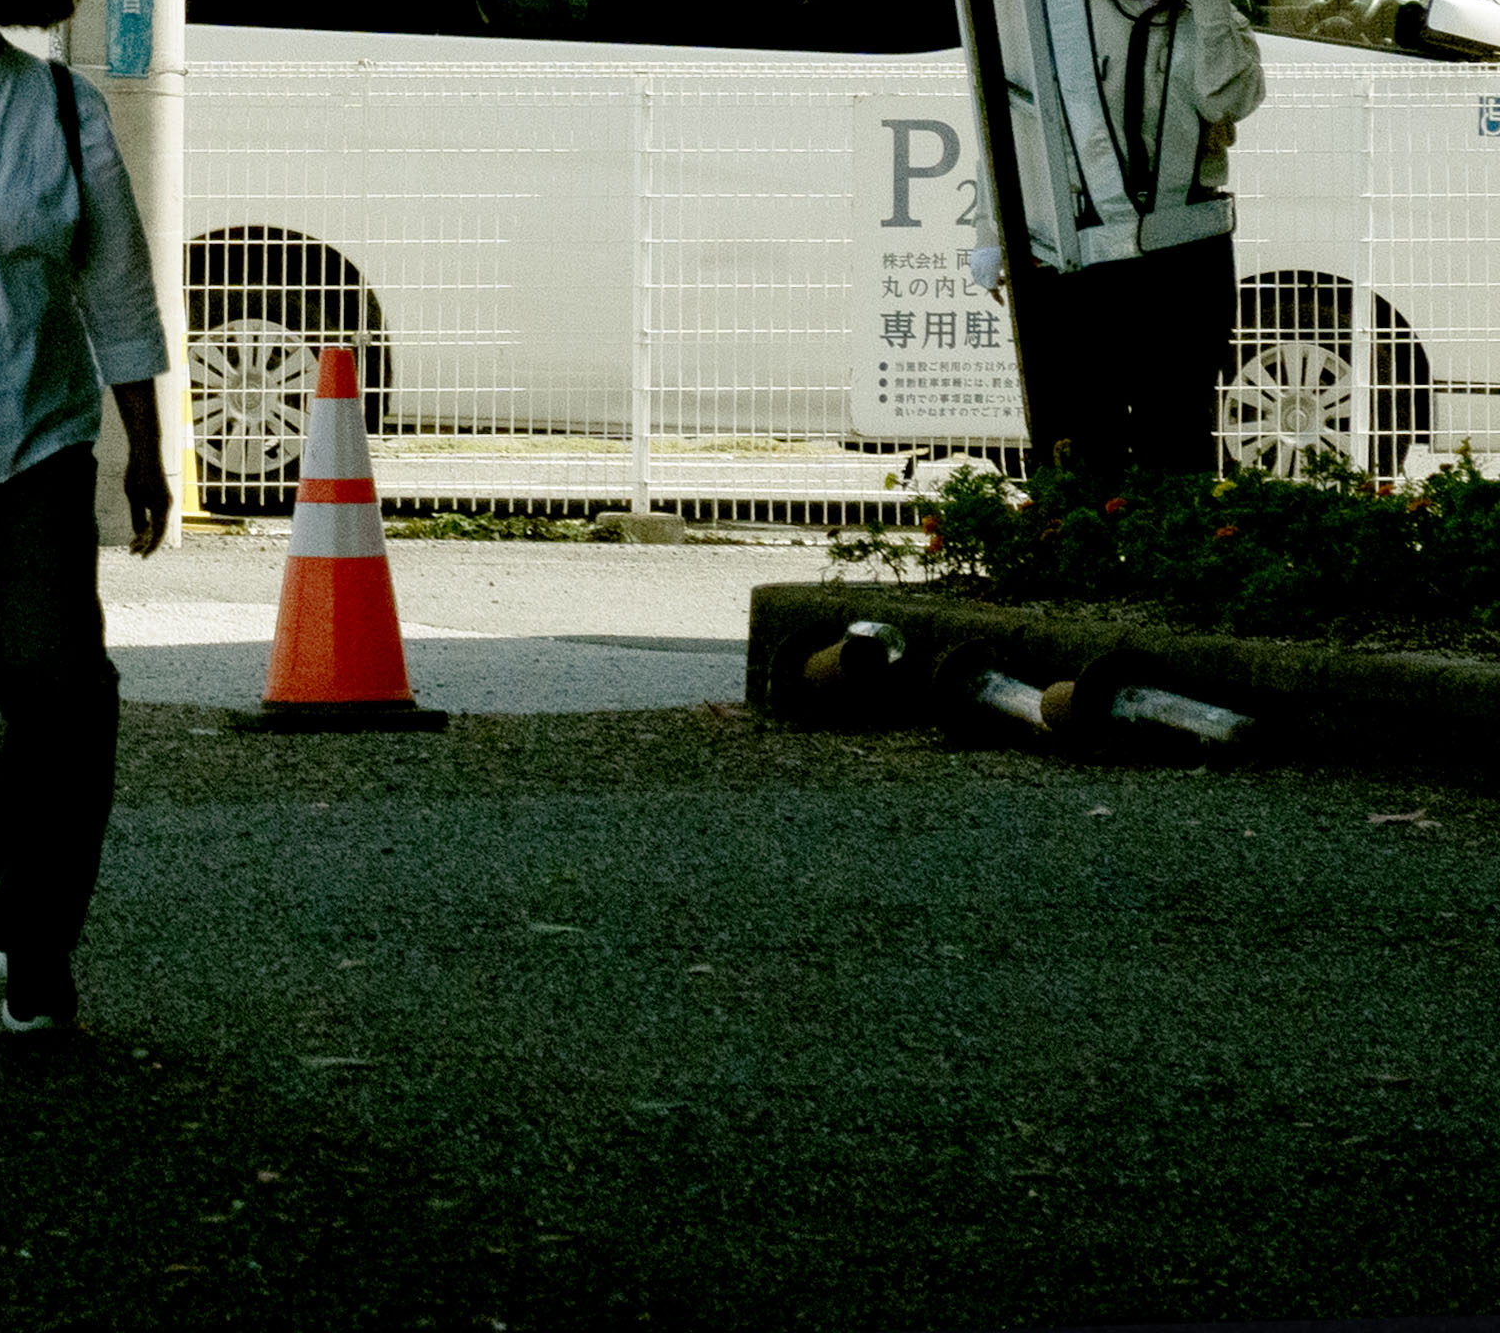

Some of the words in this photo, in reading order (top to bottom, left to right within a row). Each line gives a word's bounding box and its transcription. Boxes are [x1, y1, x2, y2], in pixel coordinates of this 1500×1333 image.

[882, 251, 948, 270] 株式会社
[880, 310, 1015, 349] 専用駐
